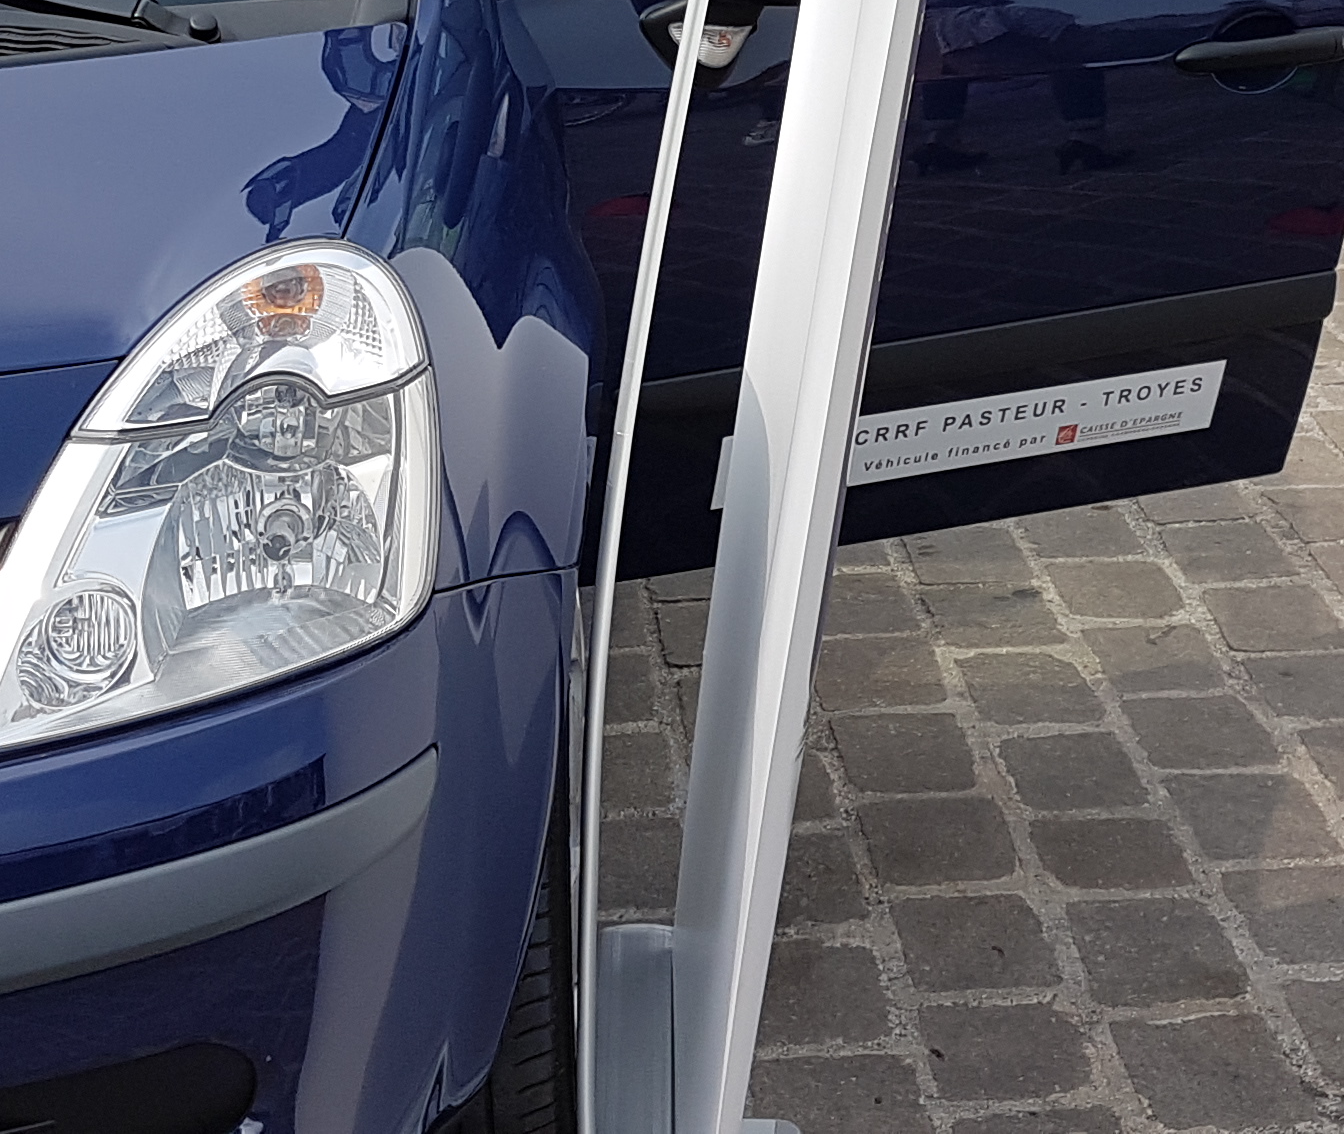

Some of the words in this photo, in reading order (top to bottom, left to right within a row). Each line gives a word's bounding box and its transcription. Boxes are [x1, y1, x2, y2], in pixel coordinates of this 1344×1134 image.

[855, 420, 930, 447] CRRF
[941, 398, 1067, 433] PASTEUR
[1101, 376, 1204, 407] TROYES
[1079, 421, 1117, 435] CAISSE
[1119, 410, 1184, 429] D'EPARGNE
[863, 451, 939, 472] Véhicule
[946, 438, 1011, 460] financé
[1018, 434, 1047, 449] par
